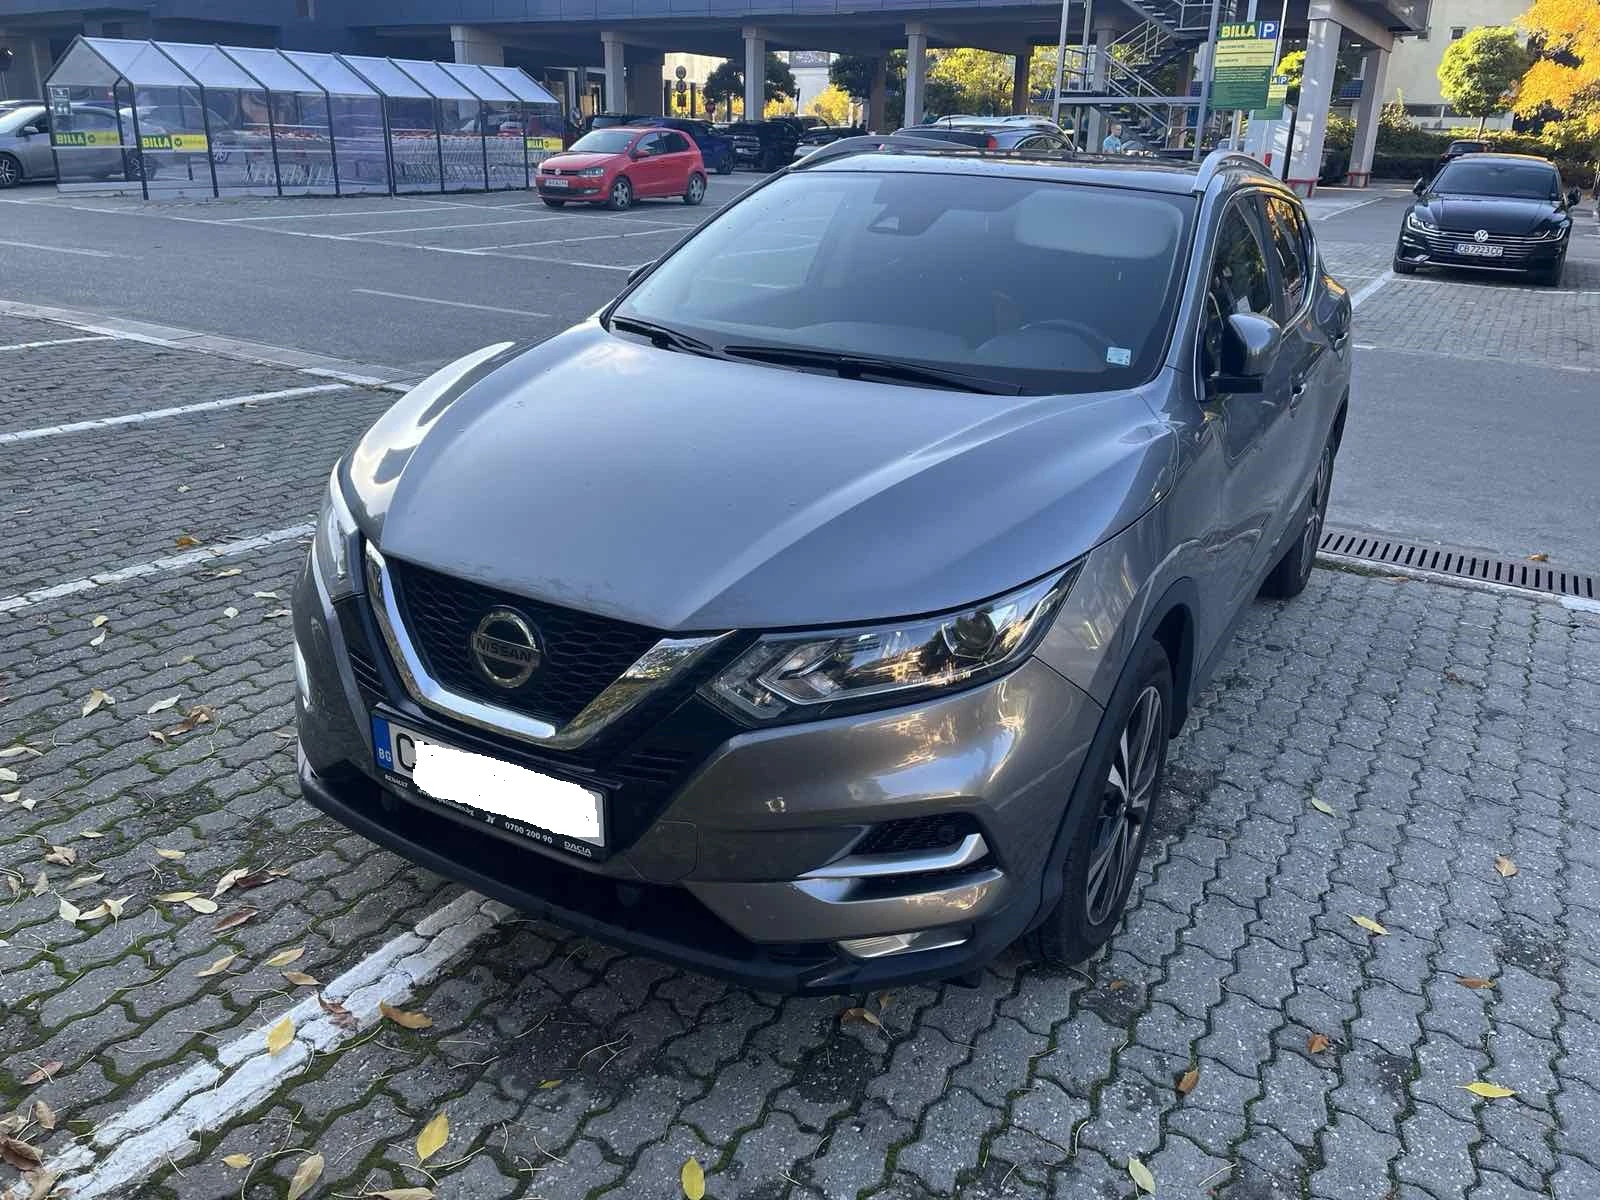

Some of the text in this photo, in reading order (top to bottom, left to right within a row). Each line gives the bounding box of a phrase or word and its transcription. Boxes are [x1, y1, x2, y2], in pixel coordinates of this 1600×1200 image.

[1221, 23, 1275, 38] BILLA P
[56, 134, 85, 145] BILLA
[142, 136, 171, 148] BILLA
[477, 637, 531, 662] NISSAN
[378, 747, 392, 762] BG
[504, 821, 553, 844] 0700 200 90
[563, 840, 592, 855] DACIA
